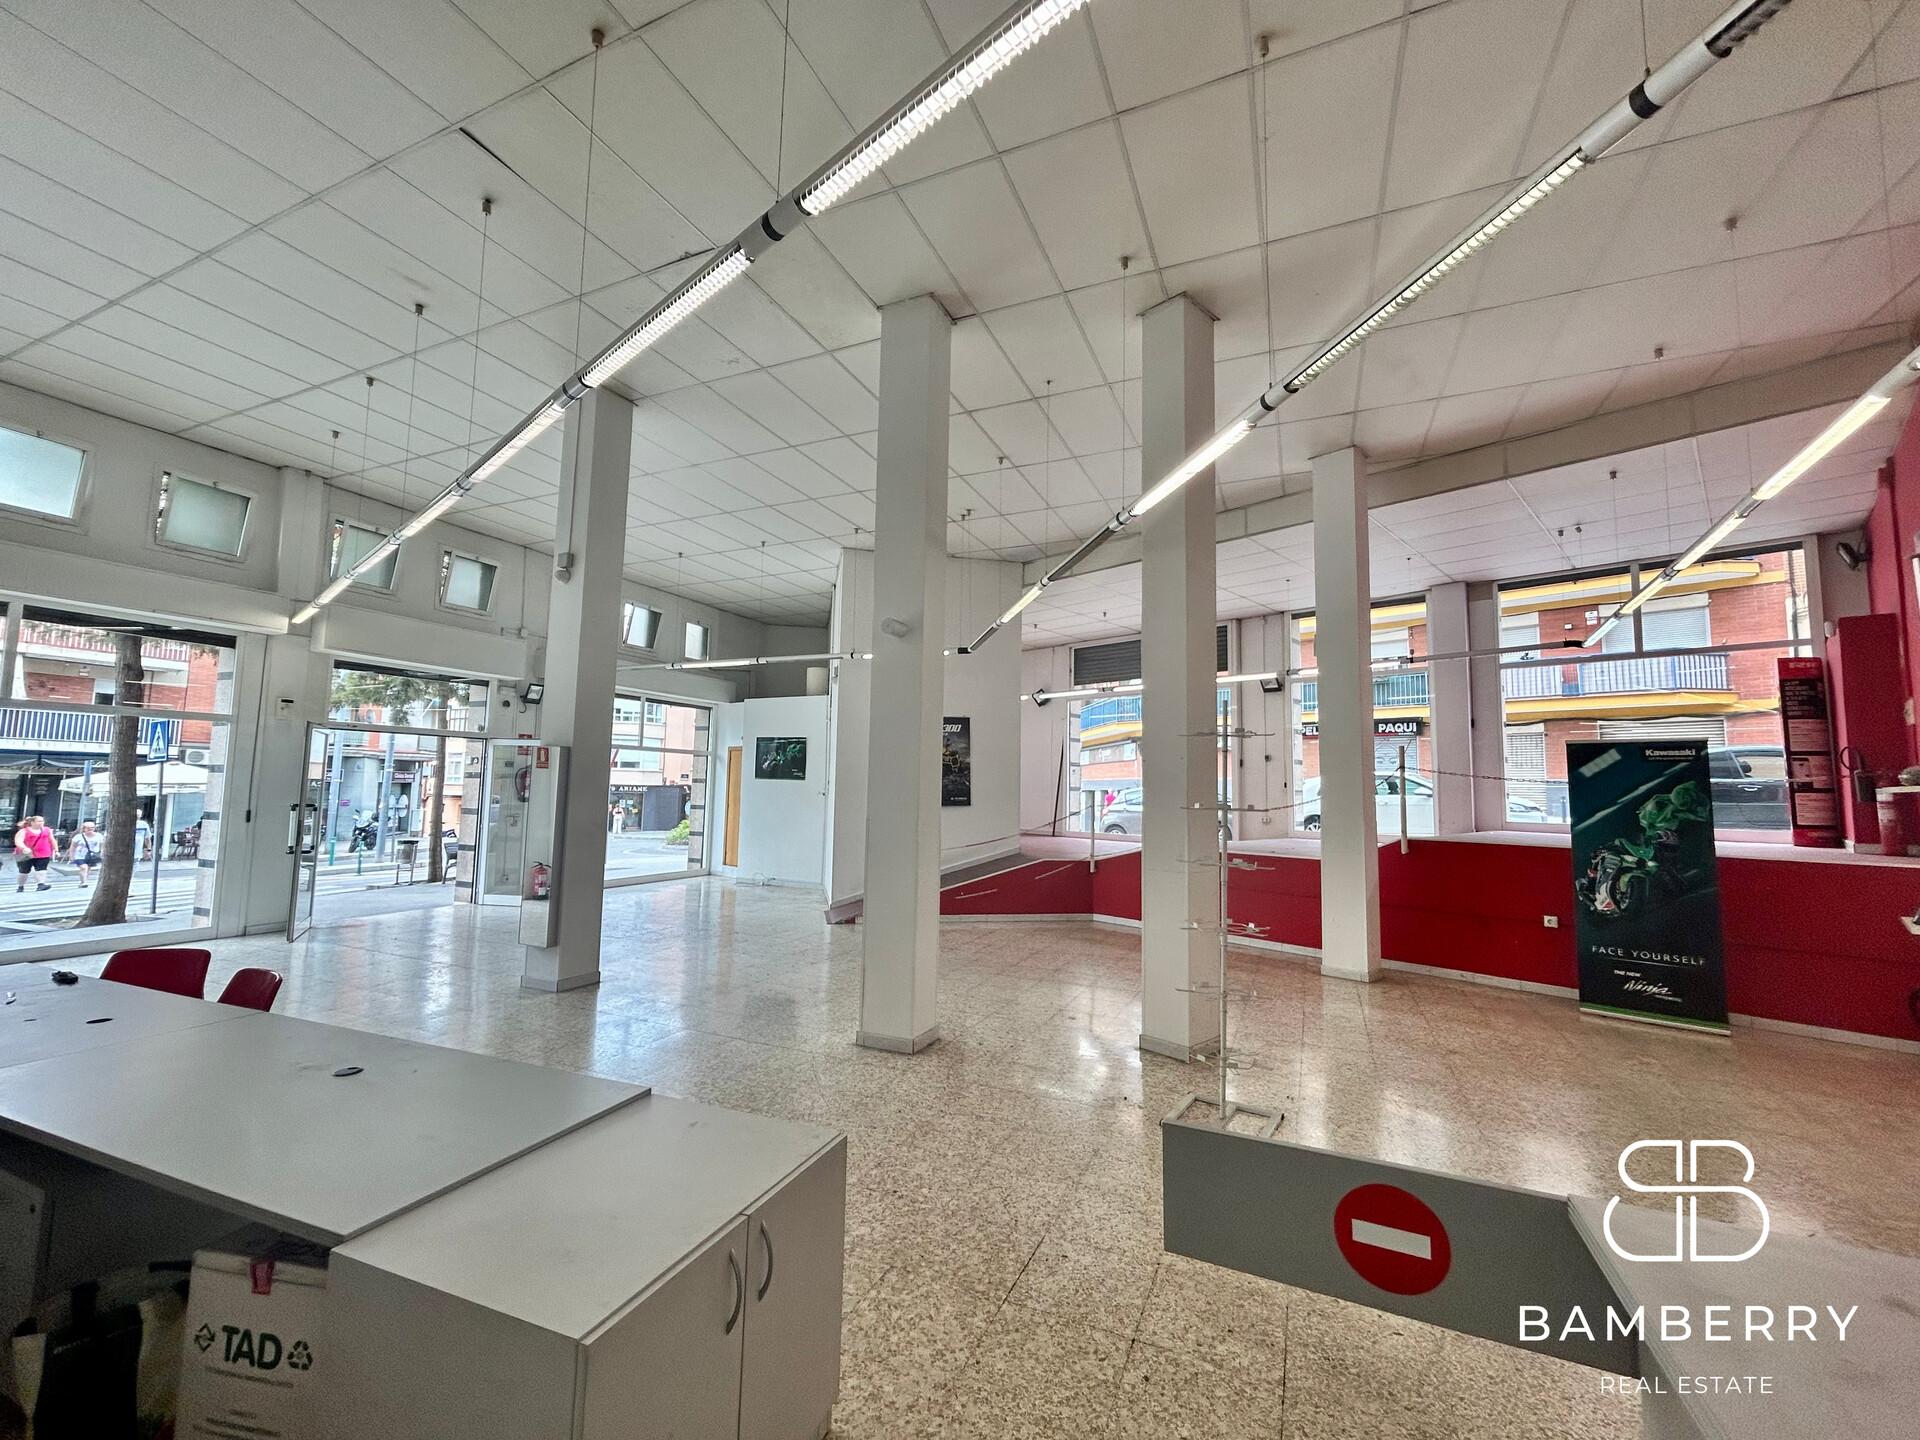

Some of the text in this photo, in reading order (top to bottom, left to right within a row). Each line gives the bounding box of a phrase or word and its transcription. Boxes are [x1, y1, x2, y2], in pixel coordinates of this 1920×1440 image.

[1378, 722, 1417, 733] PAQUI
[1592, 945, 1706, 966] FACE YOURSELF
[1623, 980, 1672, 996] Ninja
[221, 1324, 283, 1370] TAD
